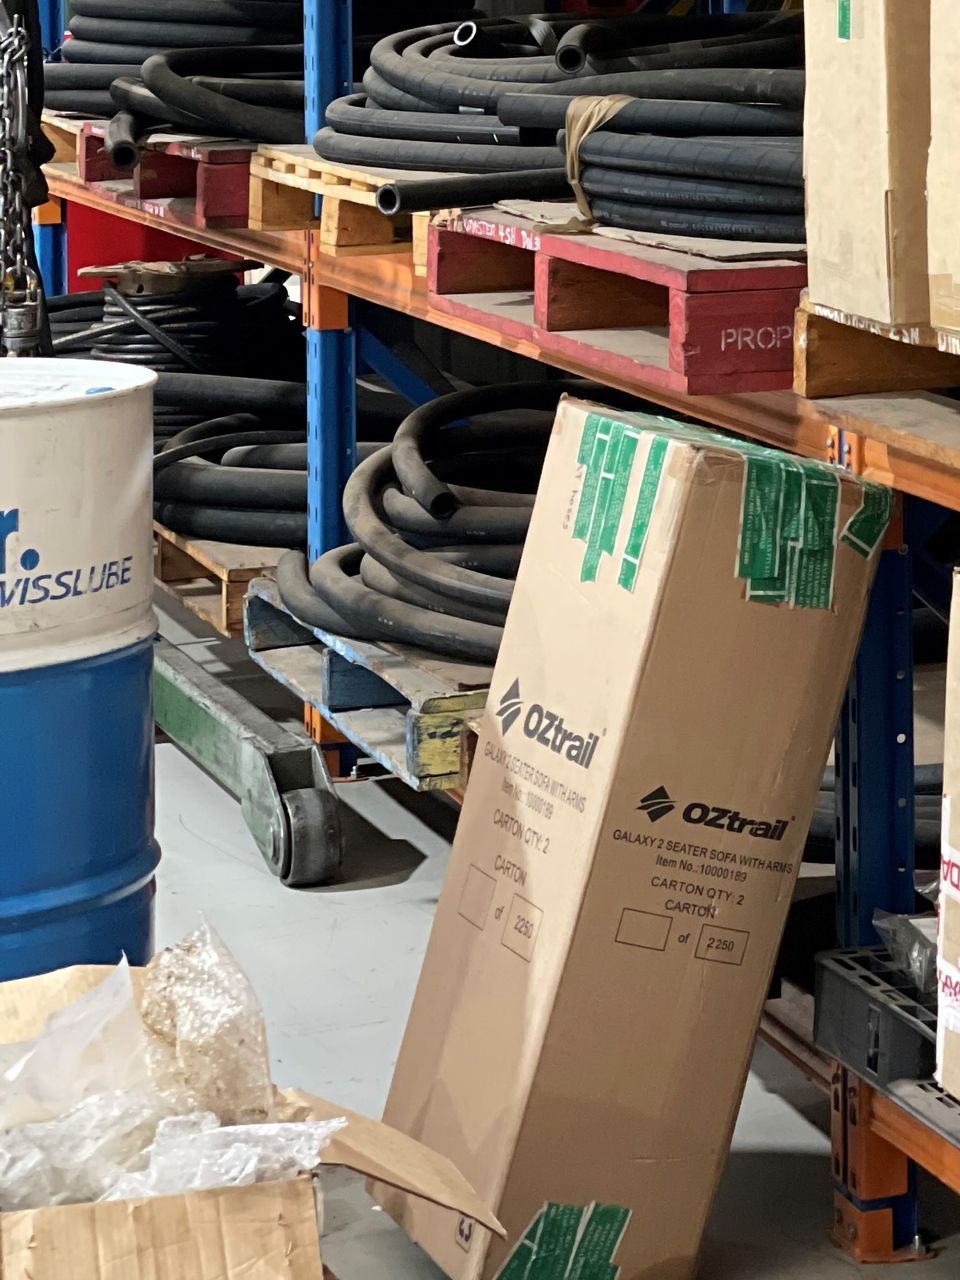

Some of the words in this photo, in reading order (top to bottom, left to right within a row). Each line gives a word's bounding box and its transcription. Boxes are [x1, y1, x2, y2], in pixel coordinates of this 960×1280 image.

[493, 808, 525, 841] CARTON
[542, 838, 551, 855] 2
[613, 829, 657, 848] GALAXY
[657, 839, 665, 849] 2
[666, 840, 709, 858] SEATER
[709, 849, 737, 864] SOFA
[739, 855, 768, 869] WITH
[767, 860, 793, 874] ARMS
[656, 854, 677, 868] Item
[494, 854, 528, 887] CARTON
[651, 876, 704, 898] CARTON
[706, 887, 735, 903] QTY:
[736, 895, 745, 906] 2
[494, 906, 505, 921] of
[513, 914, 534, 939] 2250
[665, 899, 717, 919] CARTON
[678, 932, 691, 944] of
[706, 937, 735, 952] 2250
